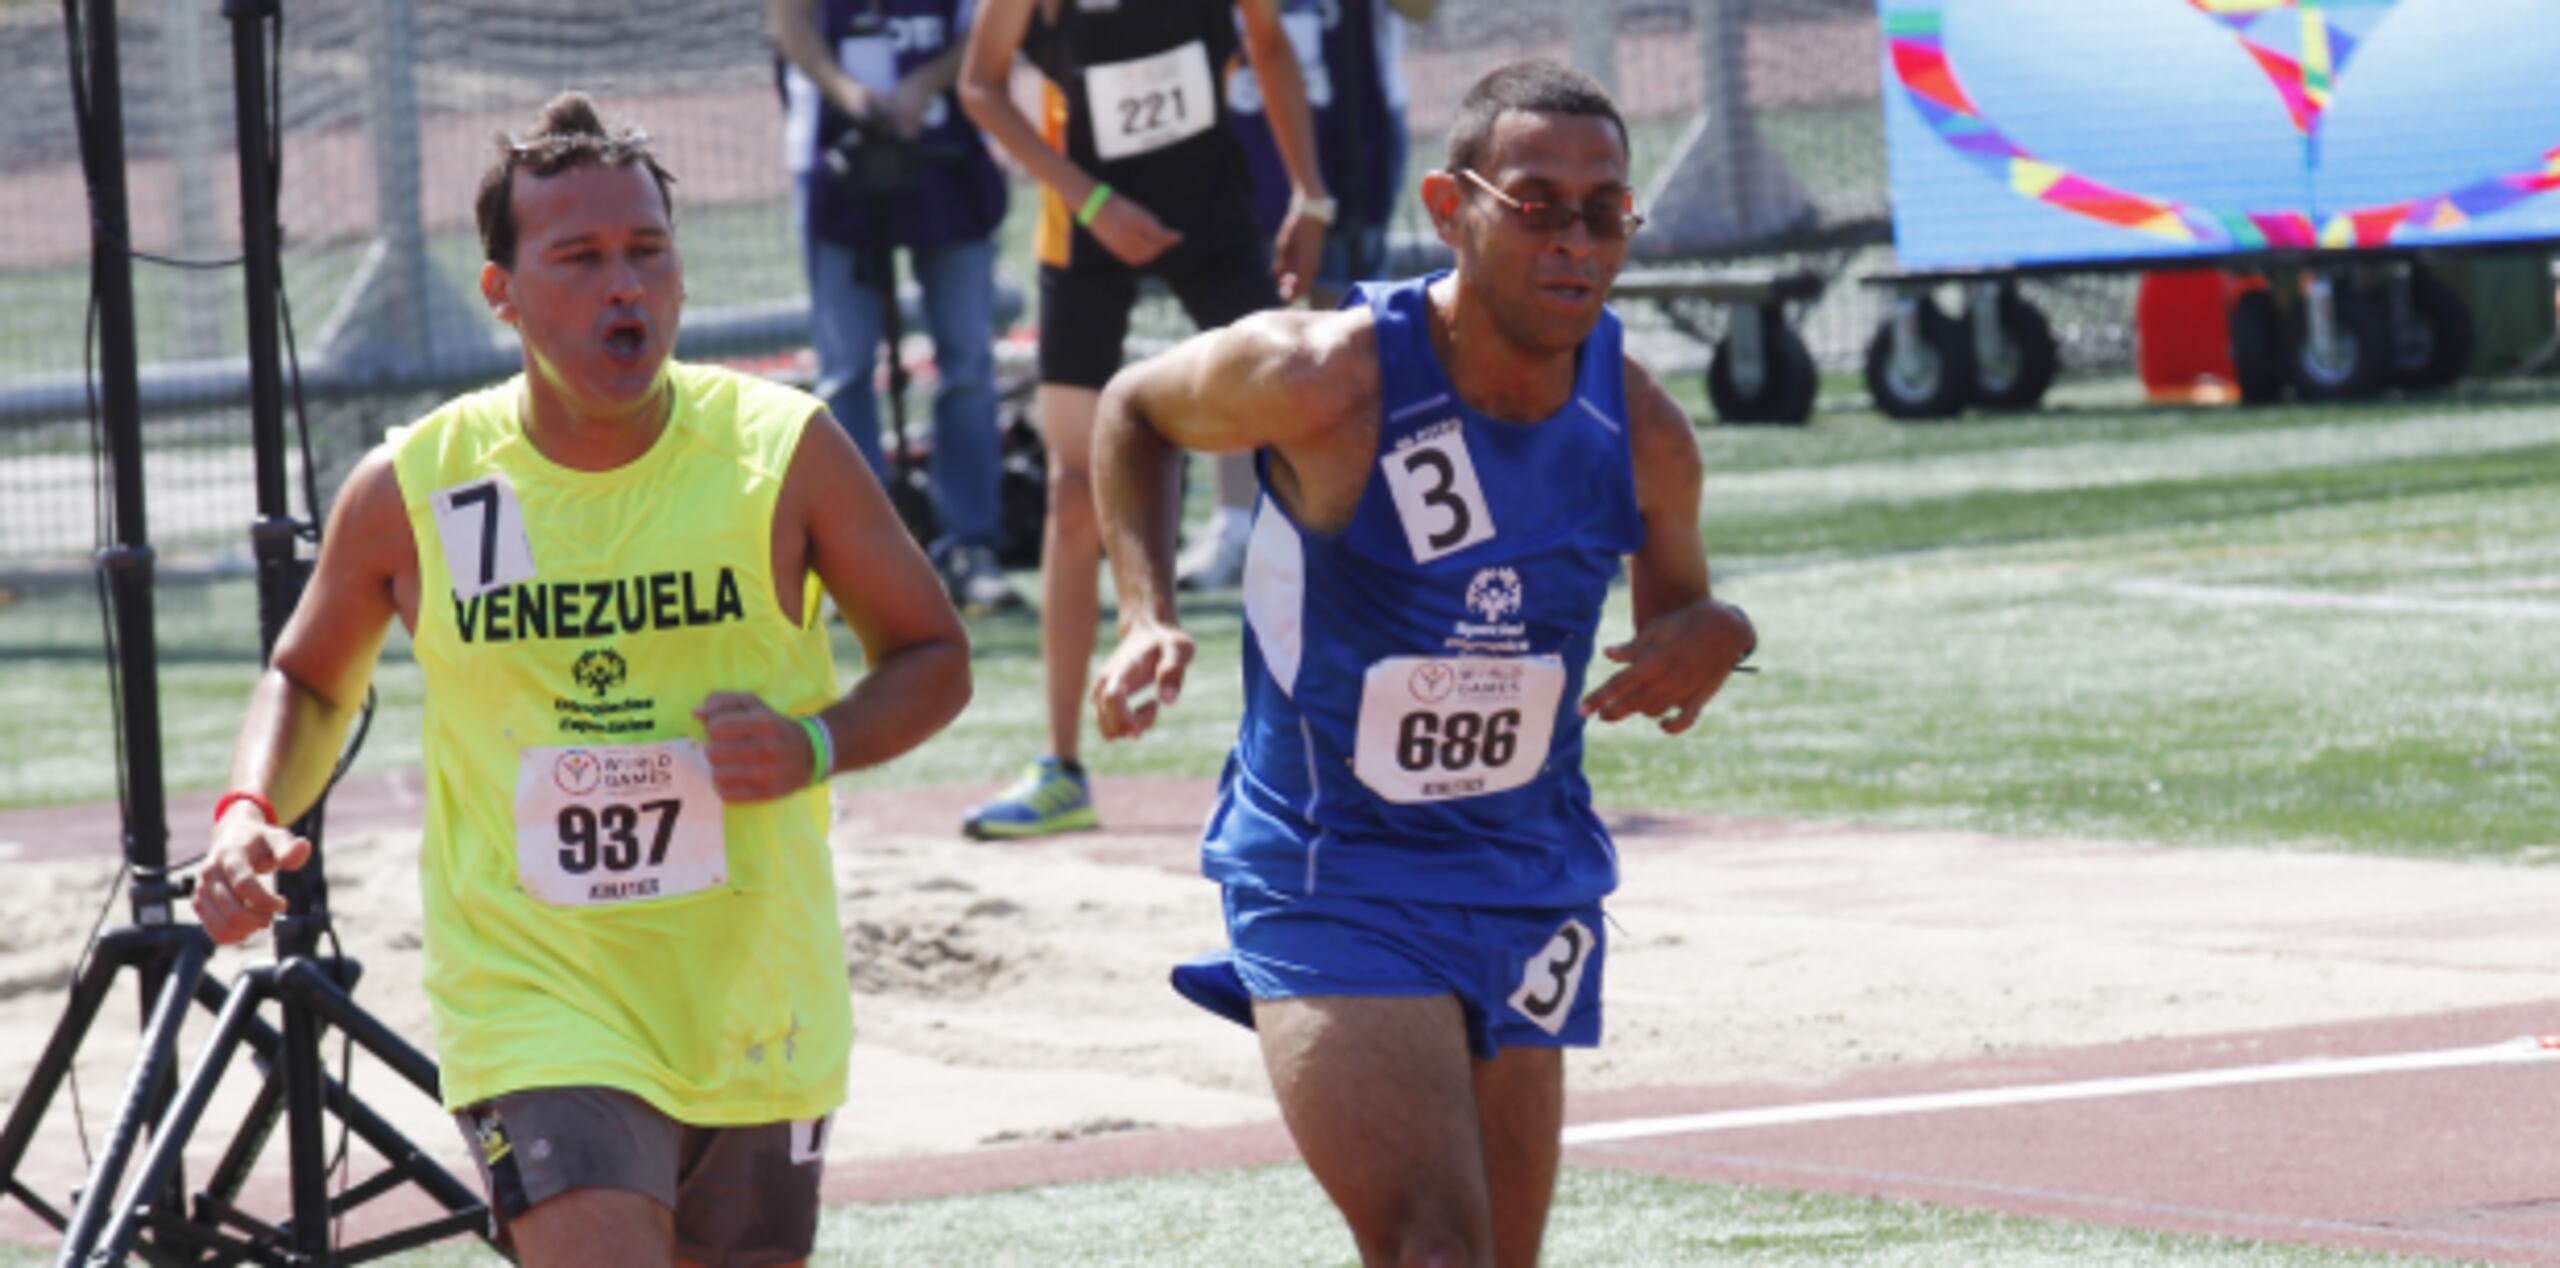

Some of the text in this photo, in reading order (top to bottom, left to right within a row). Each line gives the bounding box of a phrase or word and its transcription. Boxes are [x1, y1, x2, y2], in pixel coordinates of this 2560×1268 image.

[1118, 87, 1187, 134] 221
[450, 481, 499, 585] 7
[1404, 448, 1471, 550] 3
[451, 567, 744, 643] VENEZUELA
[1396, 707, 1521, 772] 686
[603, 770, 672, 788] GAMES
[557, 797, 683, 875] 937
[1524, 925, 1582, 1019] 3
